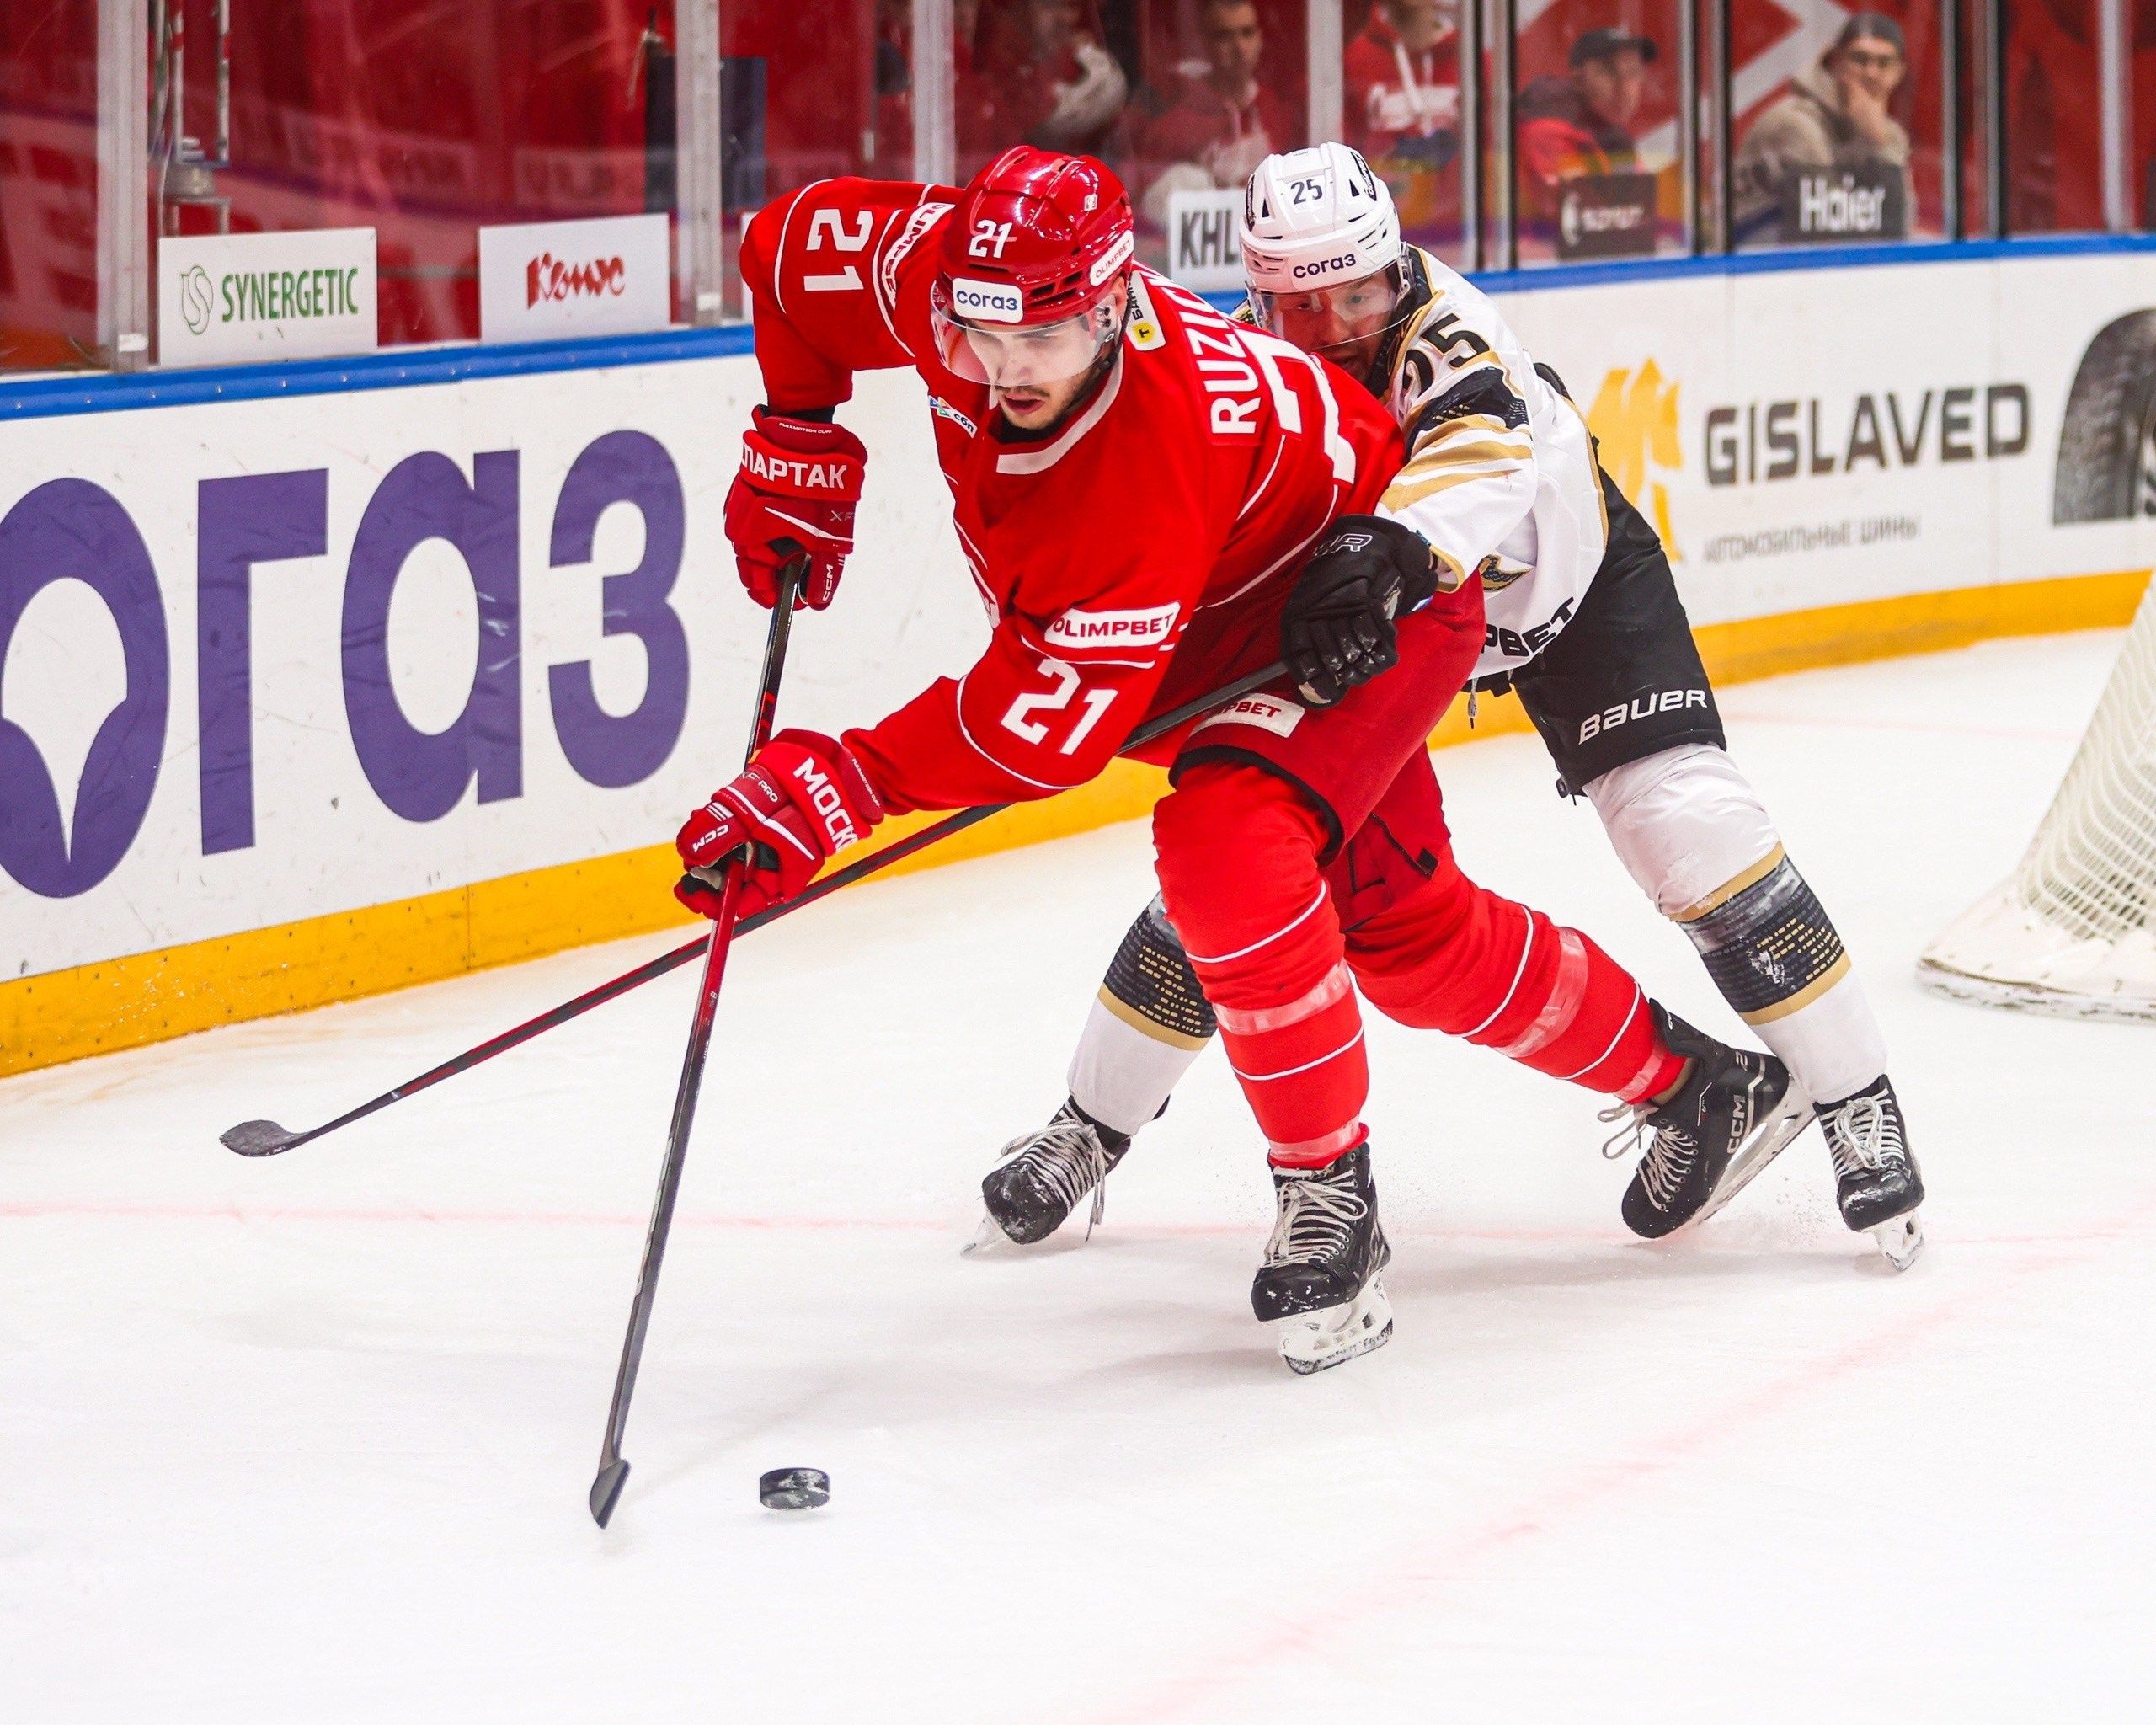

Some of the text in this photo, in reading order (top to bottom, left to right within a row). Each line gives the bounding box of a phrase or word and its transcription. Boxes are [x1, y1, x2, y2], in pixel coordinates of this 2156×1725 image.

[1290, 178, 1324, 206] 25
[1799, 174, 1886, 232] Haier
[803, 208, 874, 291] 21
[886, 204, 947, 293] OLIMPBE
[969, 219, 1013, 259] 21
[1096, 238, 1133, 279] OLIMPBET
[1180, 208, 1241, 269] KHL
[1293, 253, 1357, 279] согаз
[221, 266, 360, 323] SYNERGETIC
[956, 289, 1018, 311] согаз
[1137, 266, 1262, 434] RUZIC
[779, 422, 817, 434] FLEXMOTION
[1705, 383, 2031, 487] GISLAVED
[822, 564, 834, 601] CCM
[1052, 612, 1174, 638] OLIMPBET
[1000, 658, 1119, 756] 21
[758, 779, 779, 803] PRO
[691, 823, 730, 853] CCM
[1726, 1094, 1747, 1155] CCM
